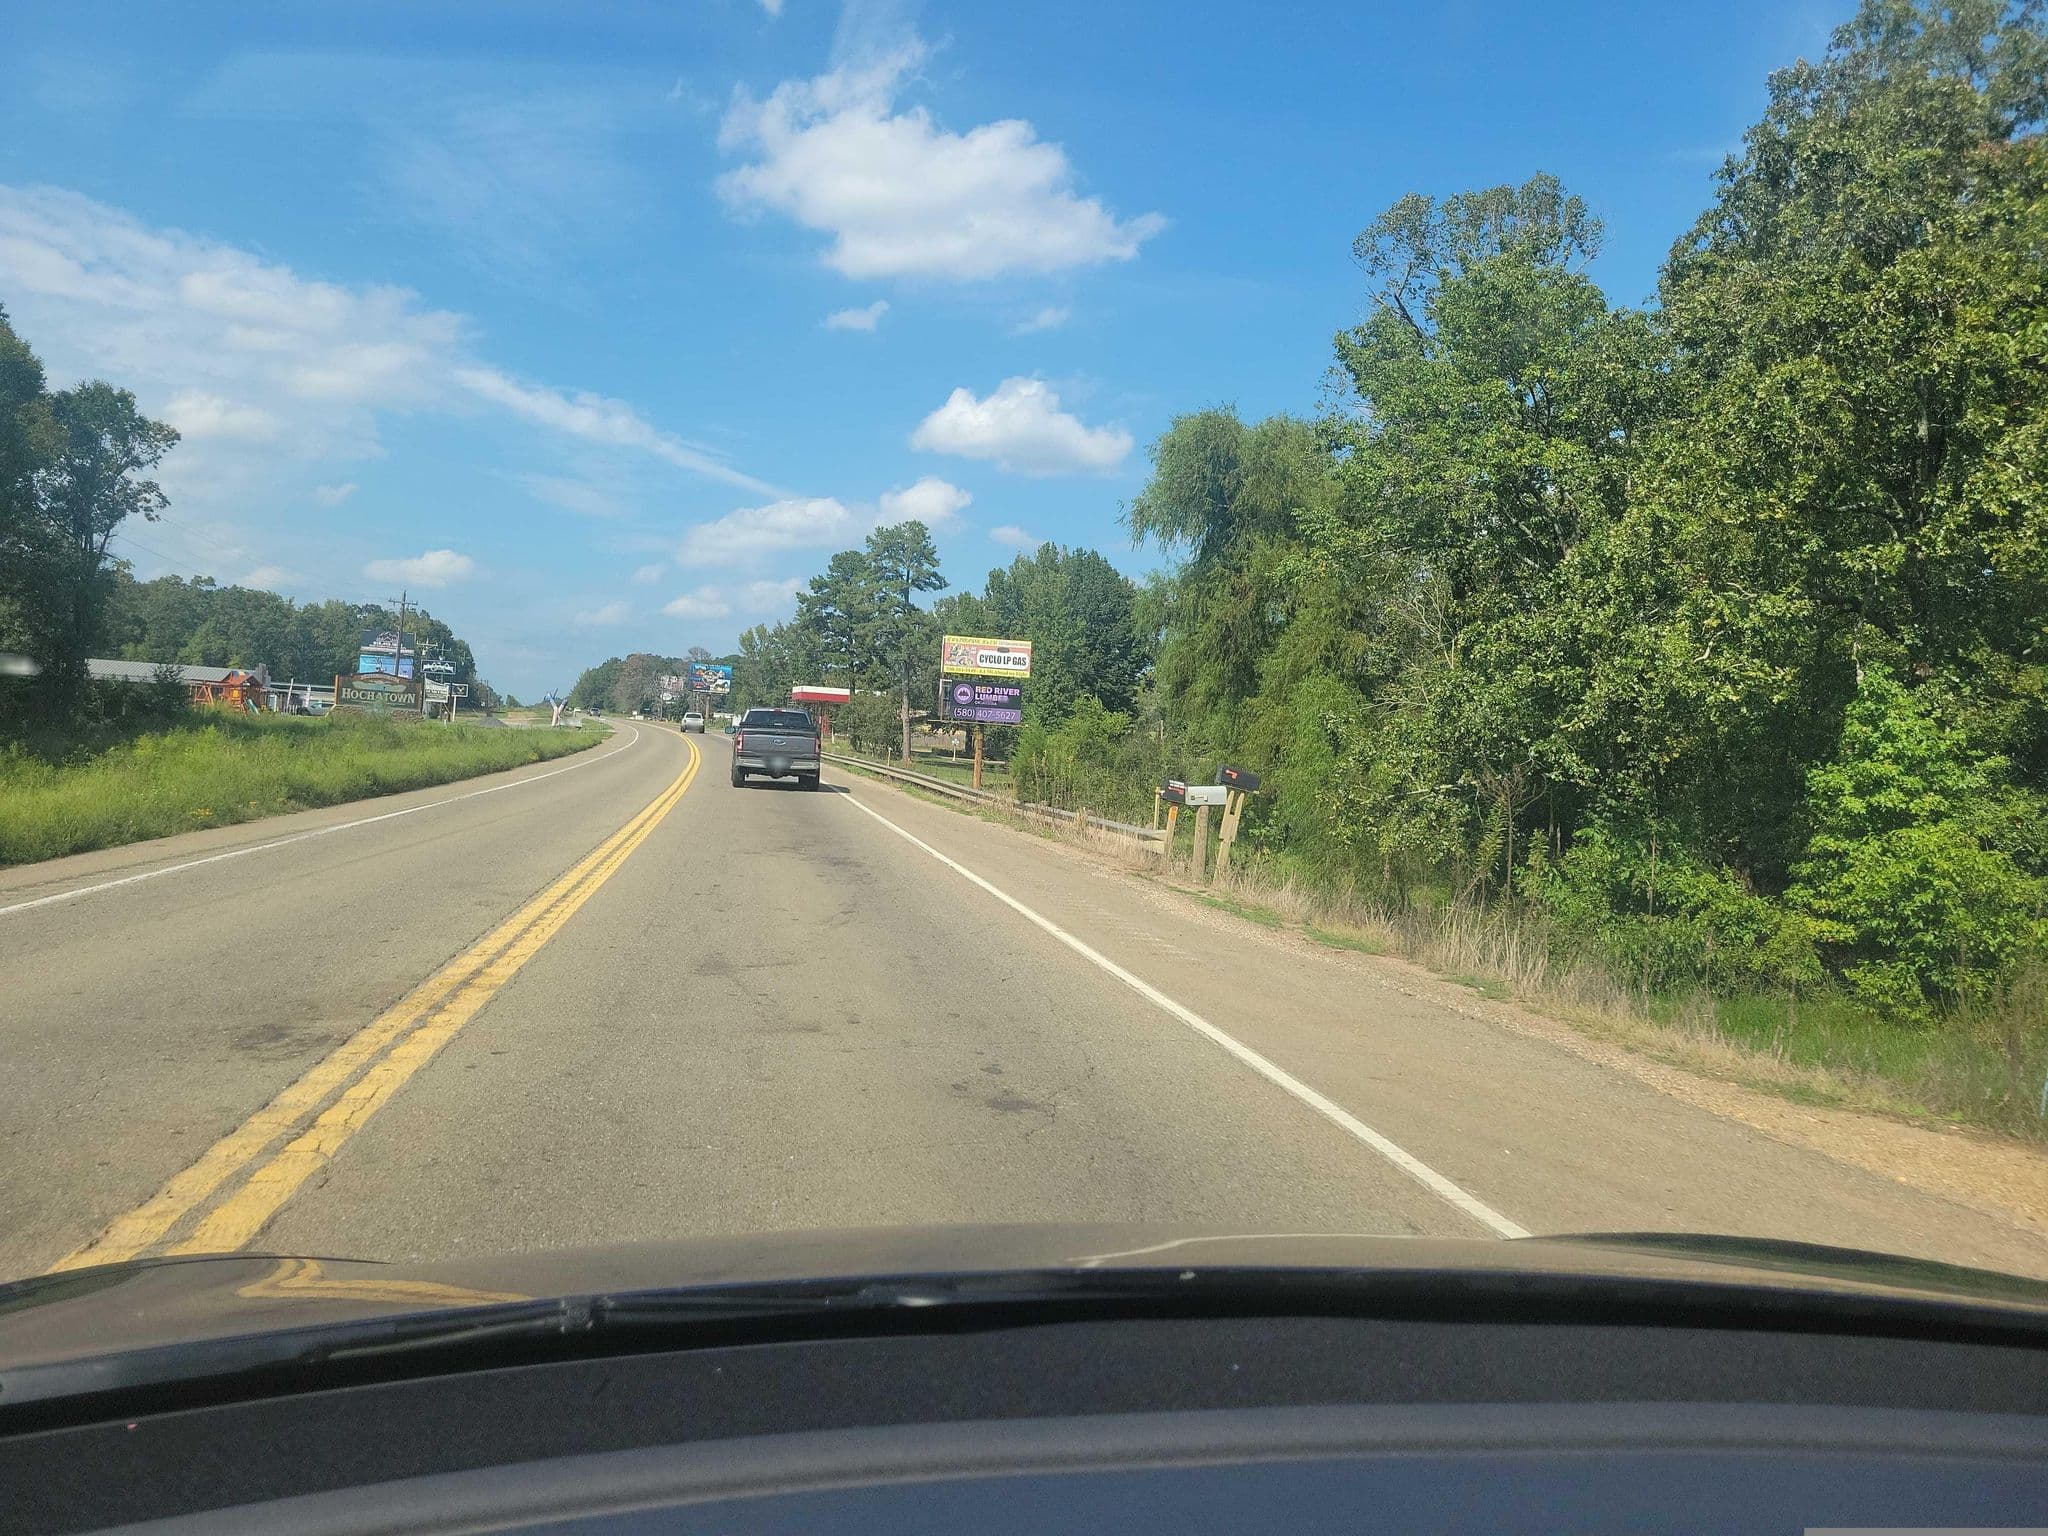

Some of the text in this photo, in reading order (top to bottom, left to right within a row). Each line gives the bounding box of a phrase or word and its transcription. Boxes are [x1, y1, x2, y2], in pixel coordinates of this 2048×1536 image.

[979, 654, 1027, 666] CYCLO LP GAS
[342, 688, 416, 703] HOCHATOWN
[975, 685, 993, 694] RED
[994, 687, 1020, 696] RIVER
[975, 693, 1009, 702] LUMBER
[954, 708, 1016, 720] (580) 407-5627
